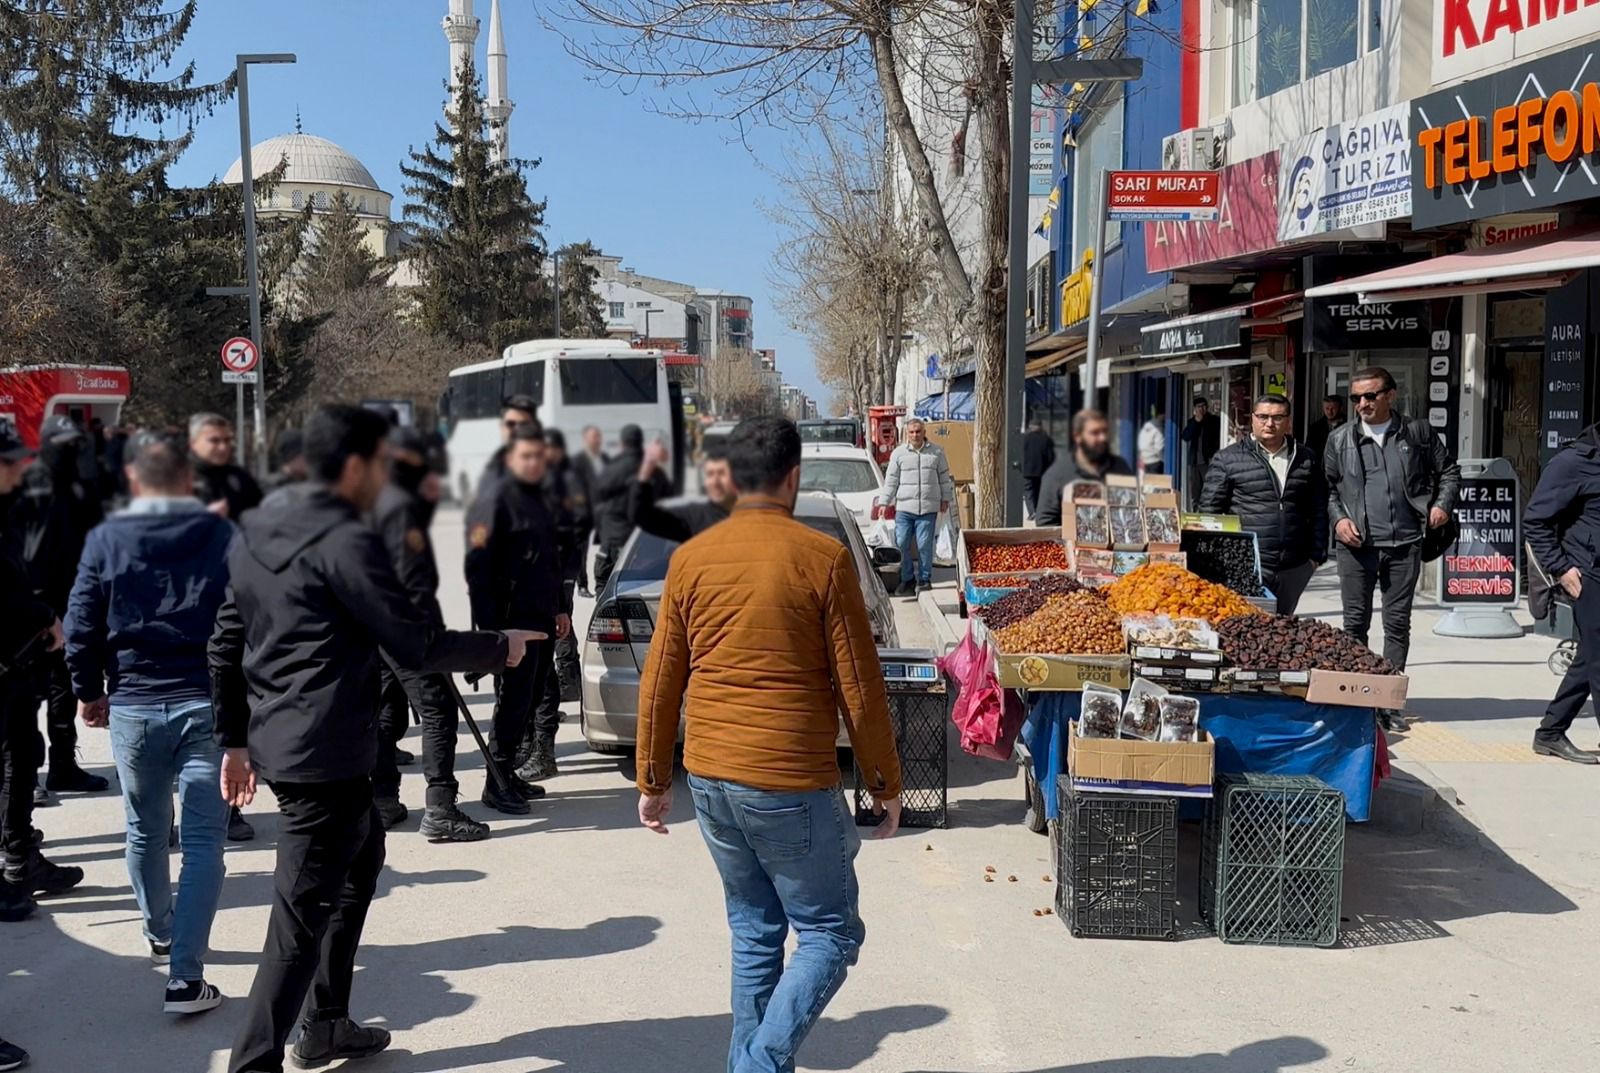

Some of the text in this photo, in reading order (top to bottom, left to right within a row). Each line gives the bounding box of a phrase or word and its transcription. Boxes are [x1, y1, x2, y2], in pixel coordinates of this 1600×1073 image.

[1033, 142, 1053, 150] ÇOR
[1322, 123, 1377, 168] ÇAĞRI
[1115, 177, 1207, 191] SARI MURAT
[1328, 303, 1392, 316] TEKNİK
[1346, 317, 1418, 331] SERVİS
[1551, 324, 1581, 340] AURA
[1554, 381, 1580, 391] iPhone
[1549, 410, 1578, 419] SAMSUNG
[1460, 488, 1512, 501] VE 2. EL
[1480, 529, 1513, 543] SATIM
[1446, 553, 1514, 572] TEKNİK
[1448, 575, 1513, 595] SERVİS
